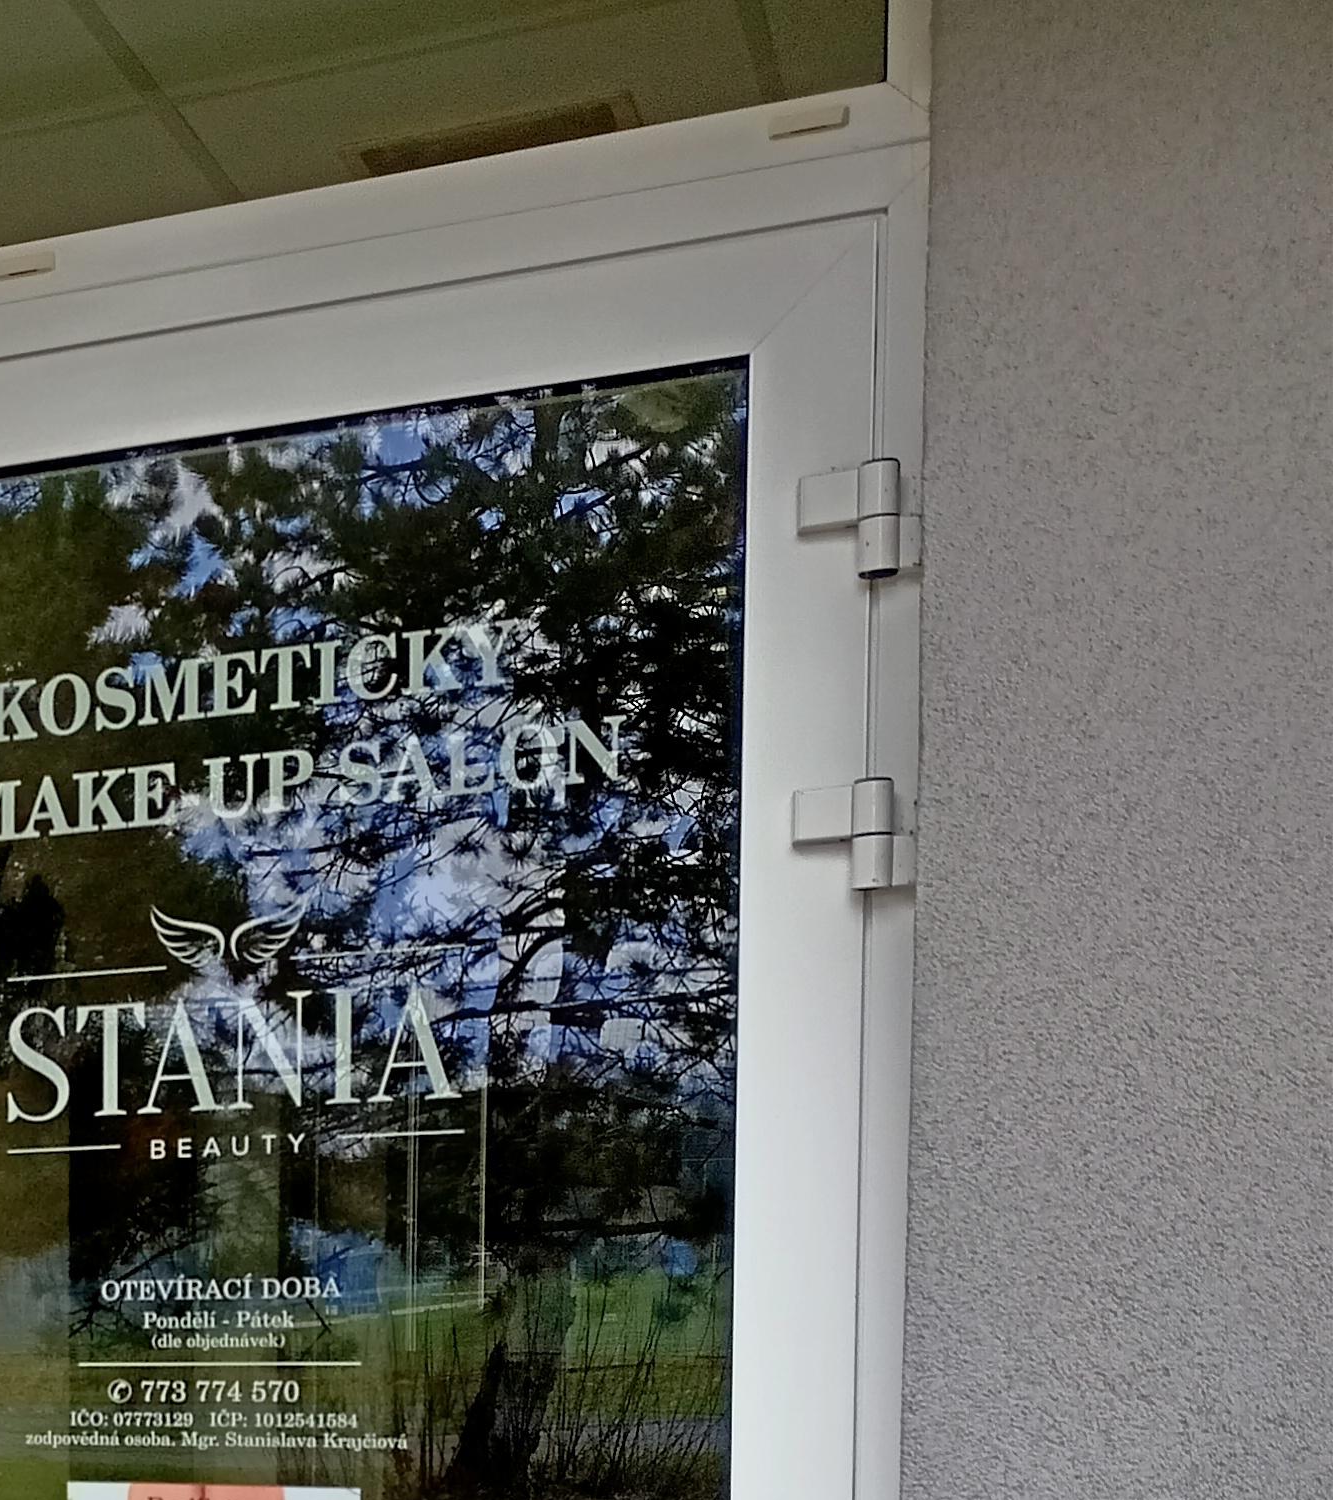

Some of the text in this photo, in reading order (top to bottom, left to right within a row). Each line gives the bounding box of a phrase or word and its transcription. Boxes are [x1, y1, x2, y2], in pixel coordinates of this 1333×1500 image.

[208, 749, 316, 820] UP
[6, 981, 462, 1124] STANIA
[149, 1132, 307, 1160] BEAUTY
[100, 1273, 342, 1301] OTEVÍRACÍ DOBA
[142, 1310, 217, 1330] Pondělí
[236, 1310, 295, 1330] Pátek
[151, 1333, 287, 1351] (dle objednávek)
[141, 1379, 300, 1404] 773 774 570
[70, 1409, 359, 1429] IČO: 07773129 IČP: 1012541584
[25, 1429, 120, 1449] zodpovědná
[181, 1433, 220, 1451] Mgr.
[225, 1431, 317, 1449] Stanislava
[323, 1432, 408, 1453] Krajčiová
